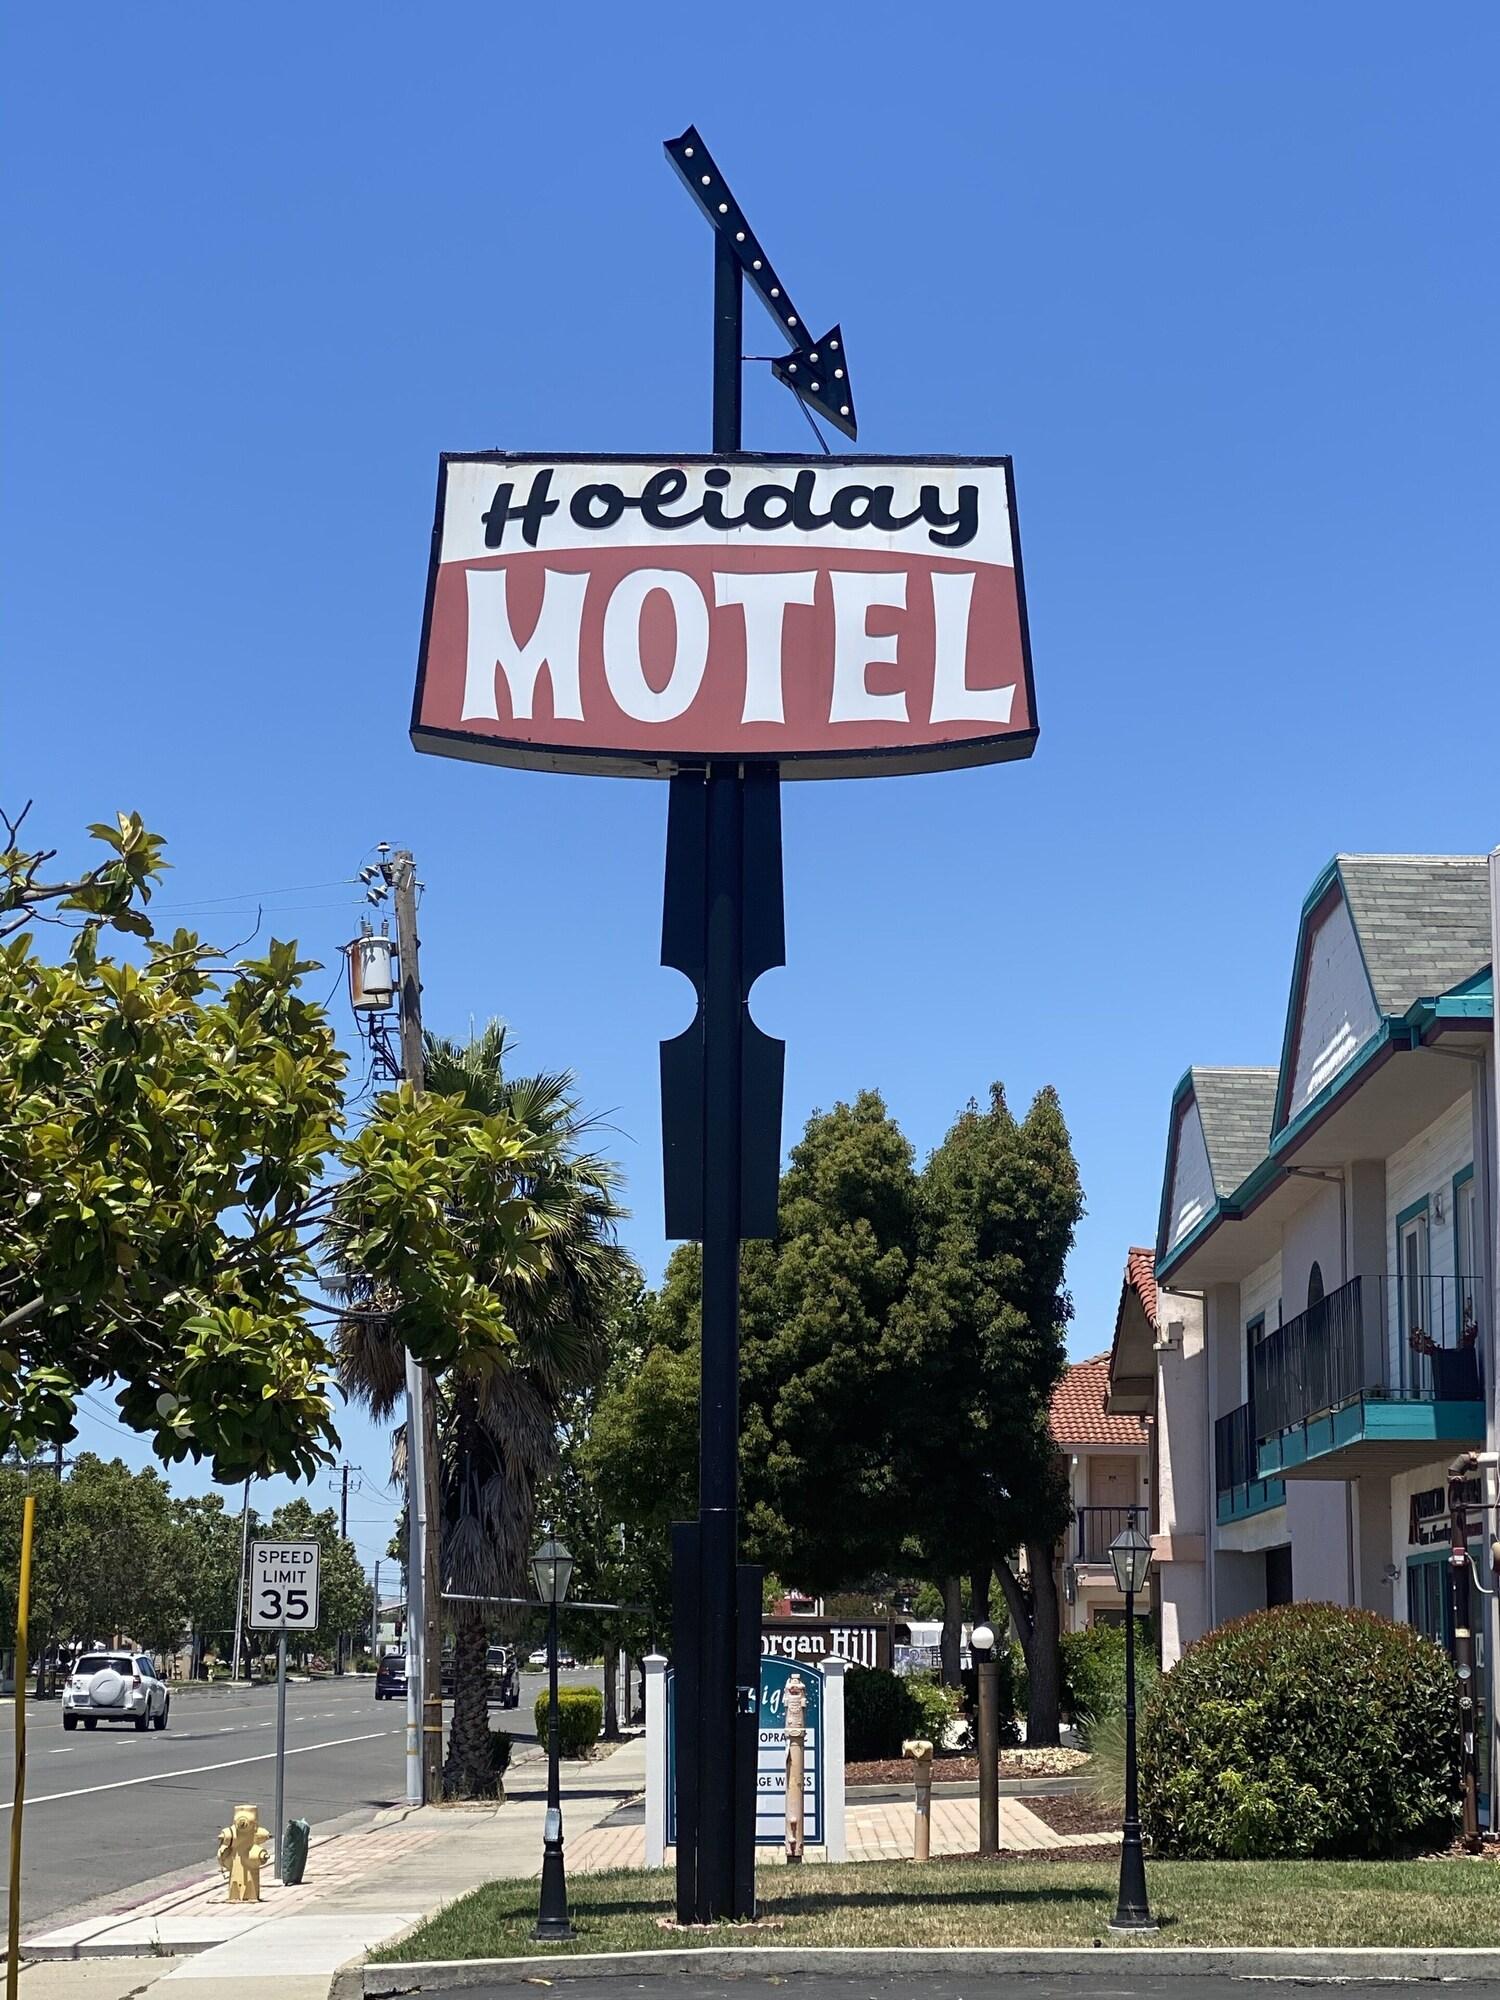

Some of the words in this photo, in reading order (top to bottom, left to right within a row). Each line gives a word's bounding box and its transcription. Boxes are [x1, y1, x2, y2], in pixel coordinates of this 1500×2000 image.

[481, 468, 979, 548] Holiday
[460, 567, 1017, 725] MOTEL
[258, 1550, 314, 1564] SPEED
[263, 1570, 307, 1584] LIMIT
[259, 1589, 309, 1620] 35
[830, 1628, 877, 1670] Hill
